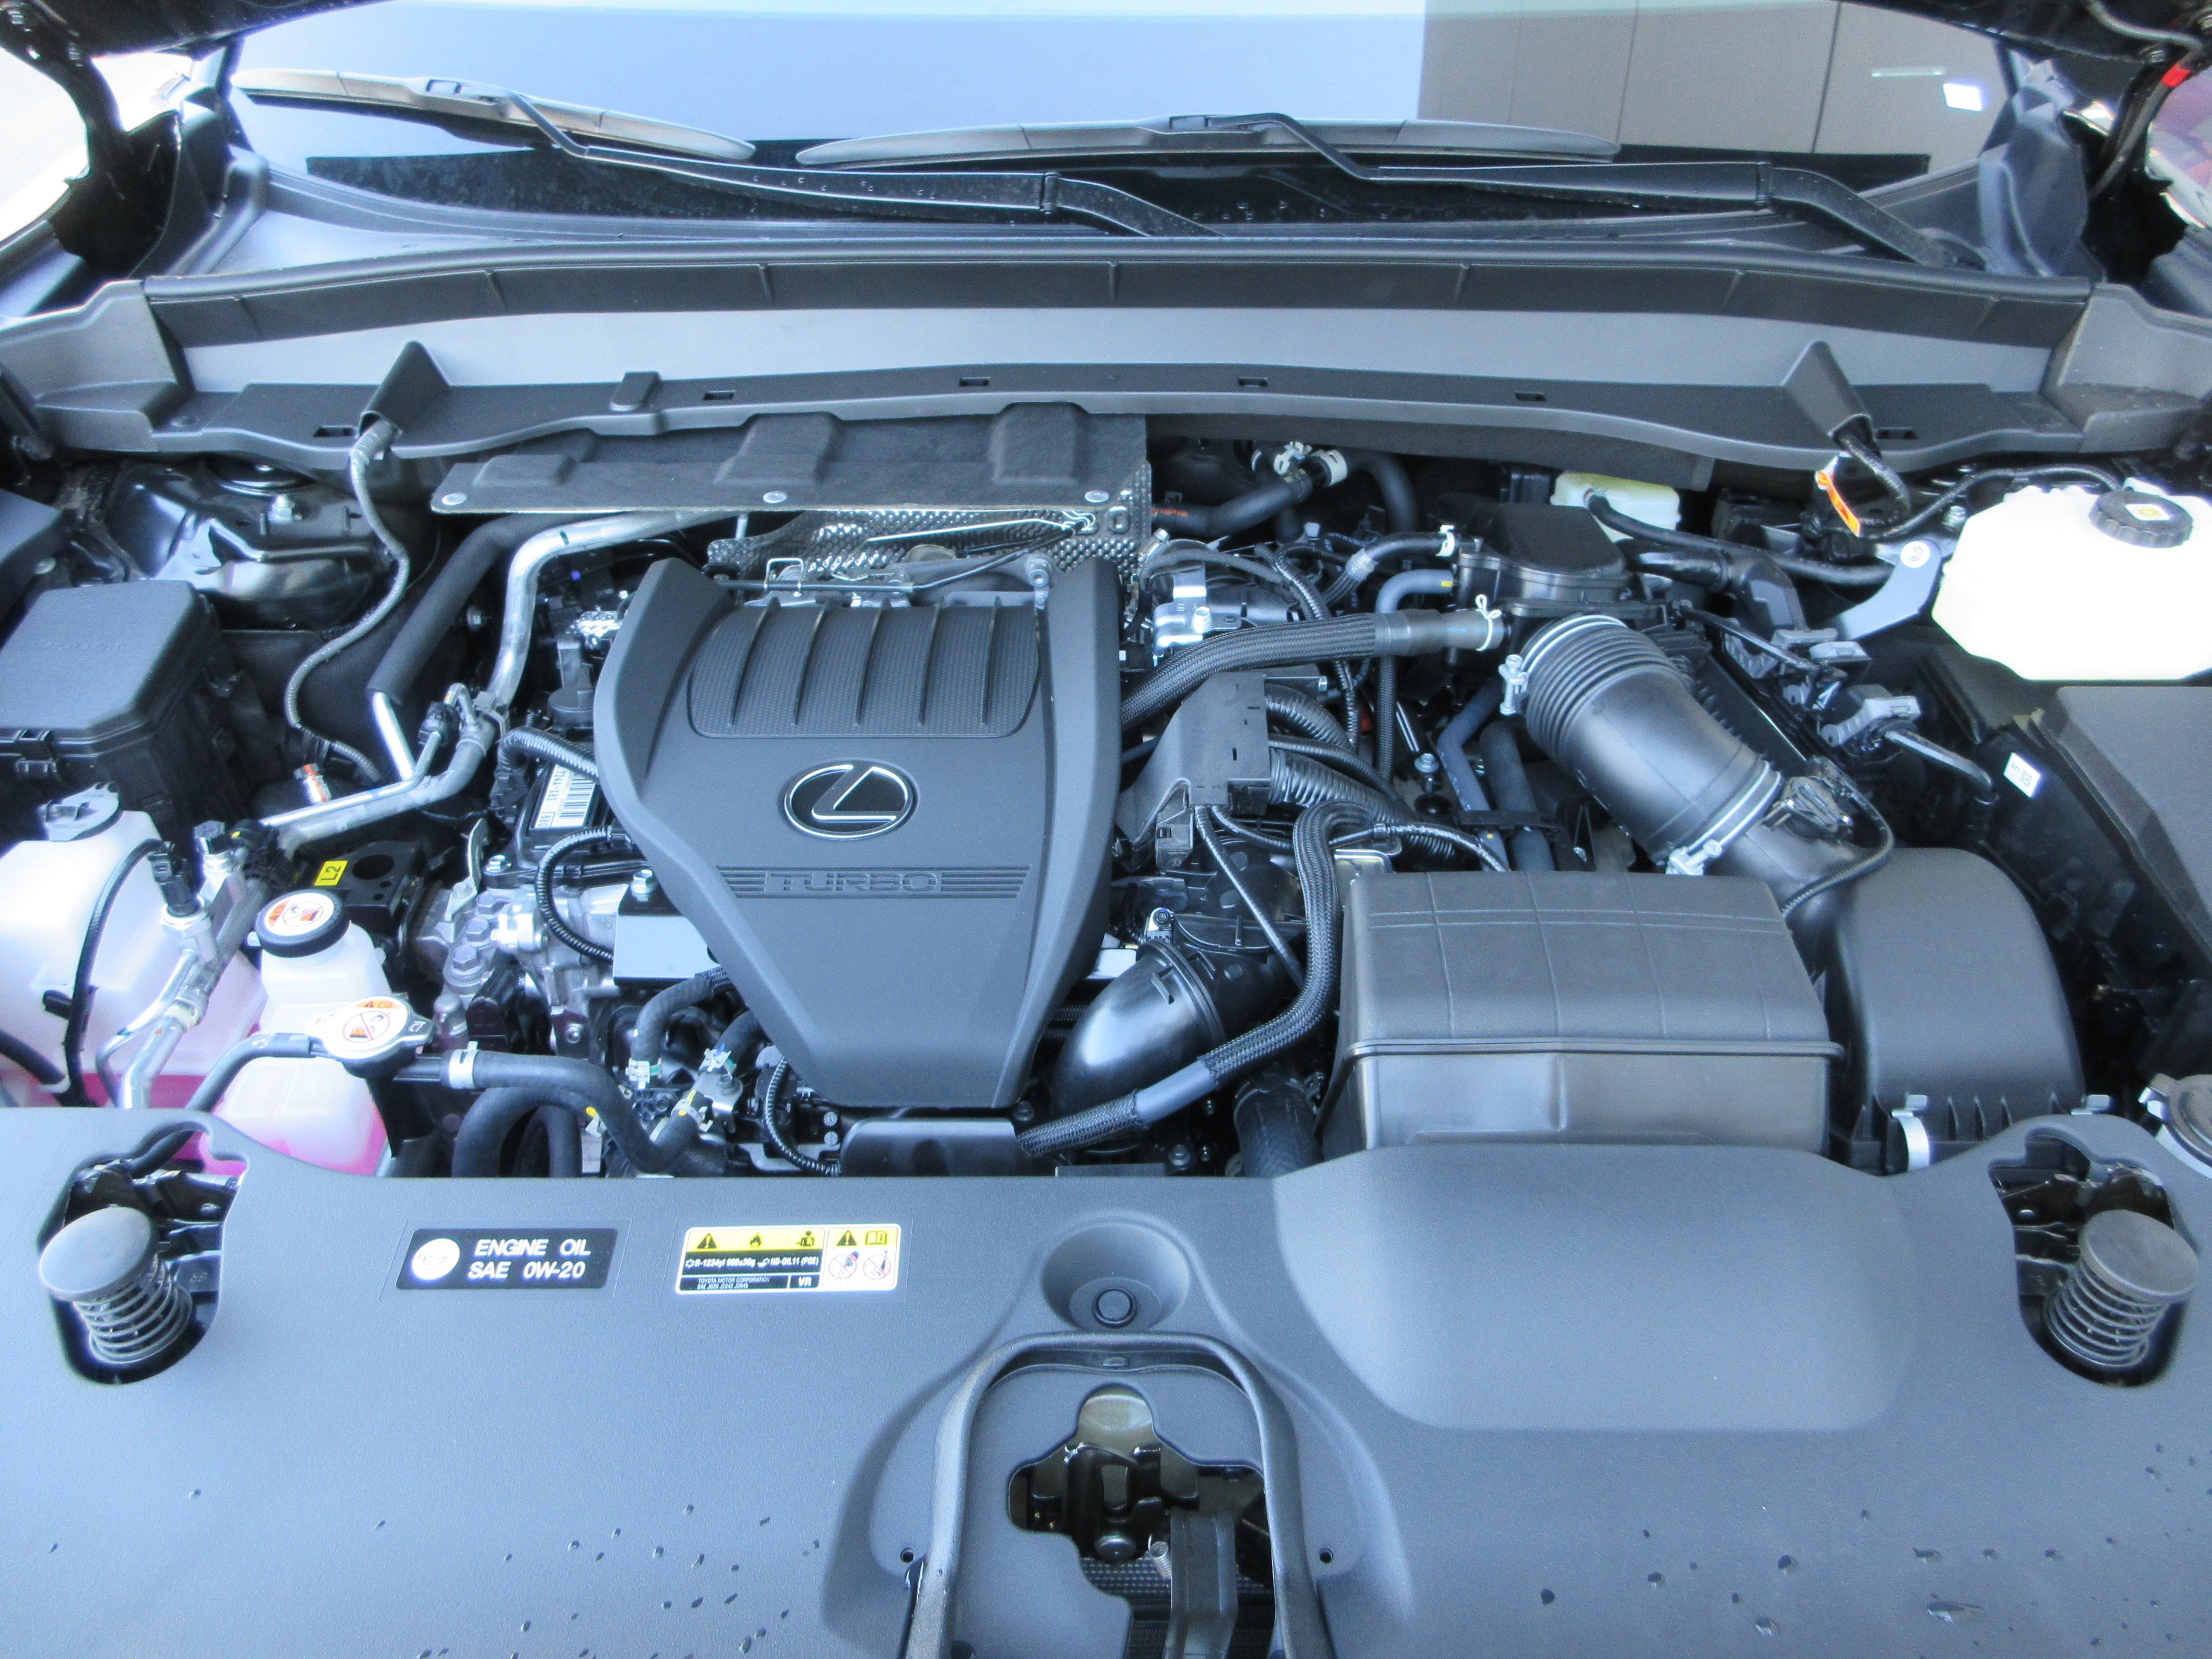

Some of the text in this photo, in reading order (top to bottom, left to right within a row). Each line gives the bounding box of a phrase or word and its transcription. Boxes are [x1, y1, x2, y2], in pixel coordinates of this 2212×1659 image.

[321, 866, 341, 880] L2
[770, 872, 938, 891] TURBO
[474, 1239, 591, 1256] ENGINE OIL
[771, 1256, 819, 1266] ND-OIL11 (POE)
[468, 1261, 586, 1278] SAE 0W-20
[798, 1277, 812, 1286] VR
